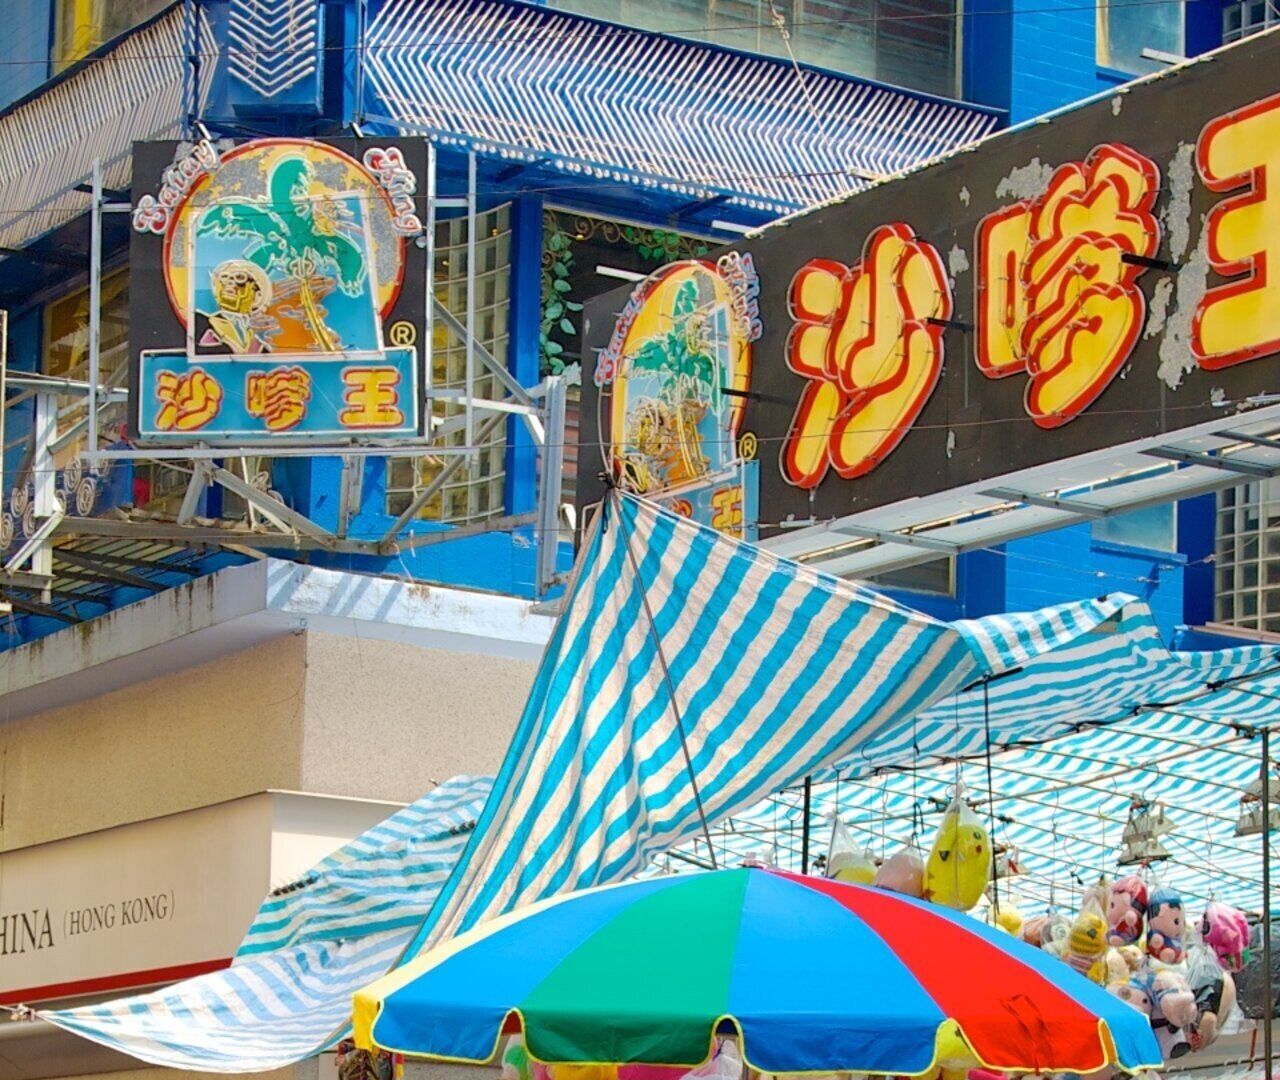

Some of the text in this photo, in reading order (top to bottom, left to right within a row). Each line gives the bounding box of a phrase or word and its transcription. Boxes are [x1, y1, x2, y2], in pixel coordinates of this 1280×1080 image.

[154, 364, 406, 432] 沙嗲王
[62, 902, 116, 940] (HONG
[120, 889, 176, 928] KONG)
